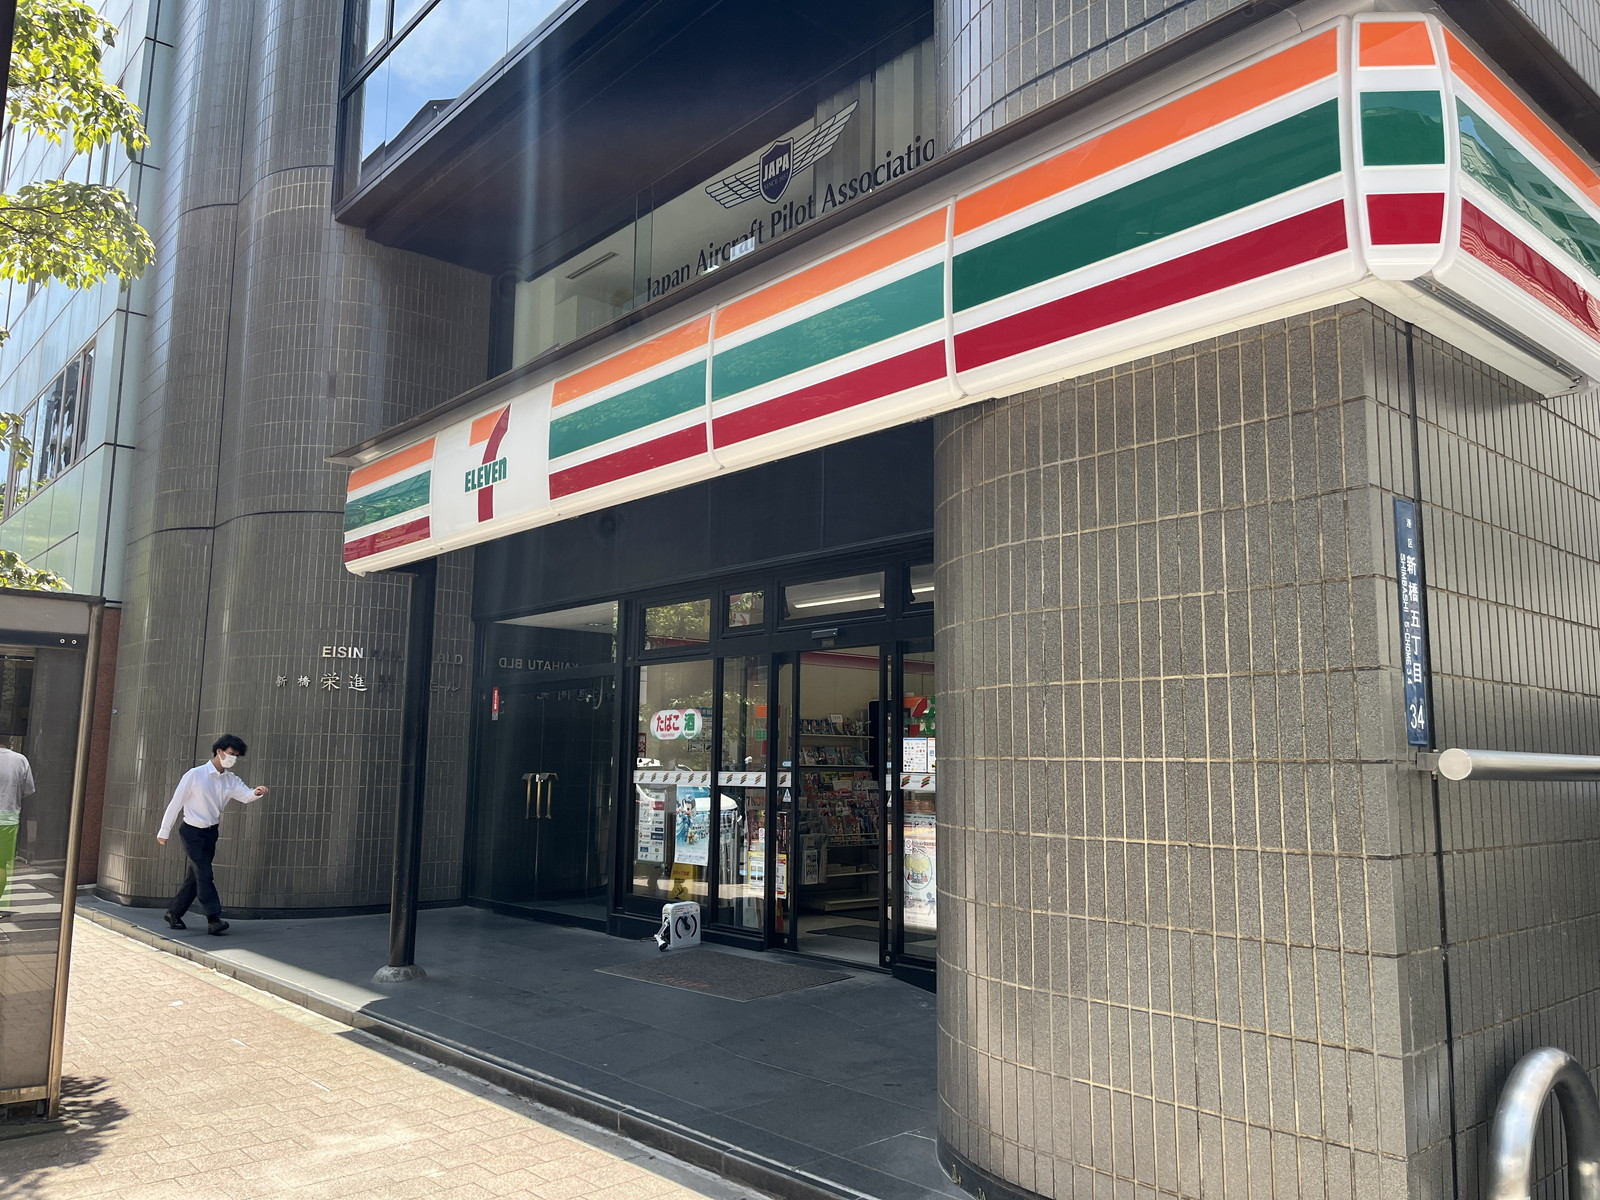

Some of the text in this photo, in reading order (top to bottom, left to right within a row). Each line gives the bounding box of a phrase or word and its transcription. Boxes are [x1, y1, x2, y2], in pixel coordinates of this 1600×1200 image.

[763, 152, 790, 183] JAPA
[646, 262, 691, 302] Japan
[696, 217, 765, 276] Aircraft
[771, 194, 816, 238] Pilot
[469, 402, 512, 523] 7
[1400, 552, 1409, 613] SHIMBASHI
[1406, 555, 1422, 683] 新橋五丁目
[322, 645, 364, 659] EISIN
[275, 675, 311, 688] 新橋
[320, 672, 368, 692] 栄進
[656, 714, 680, 732] たばこ
[684, 713, 695, 731] 酒
[1409, 703, 1425, 730] 34
